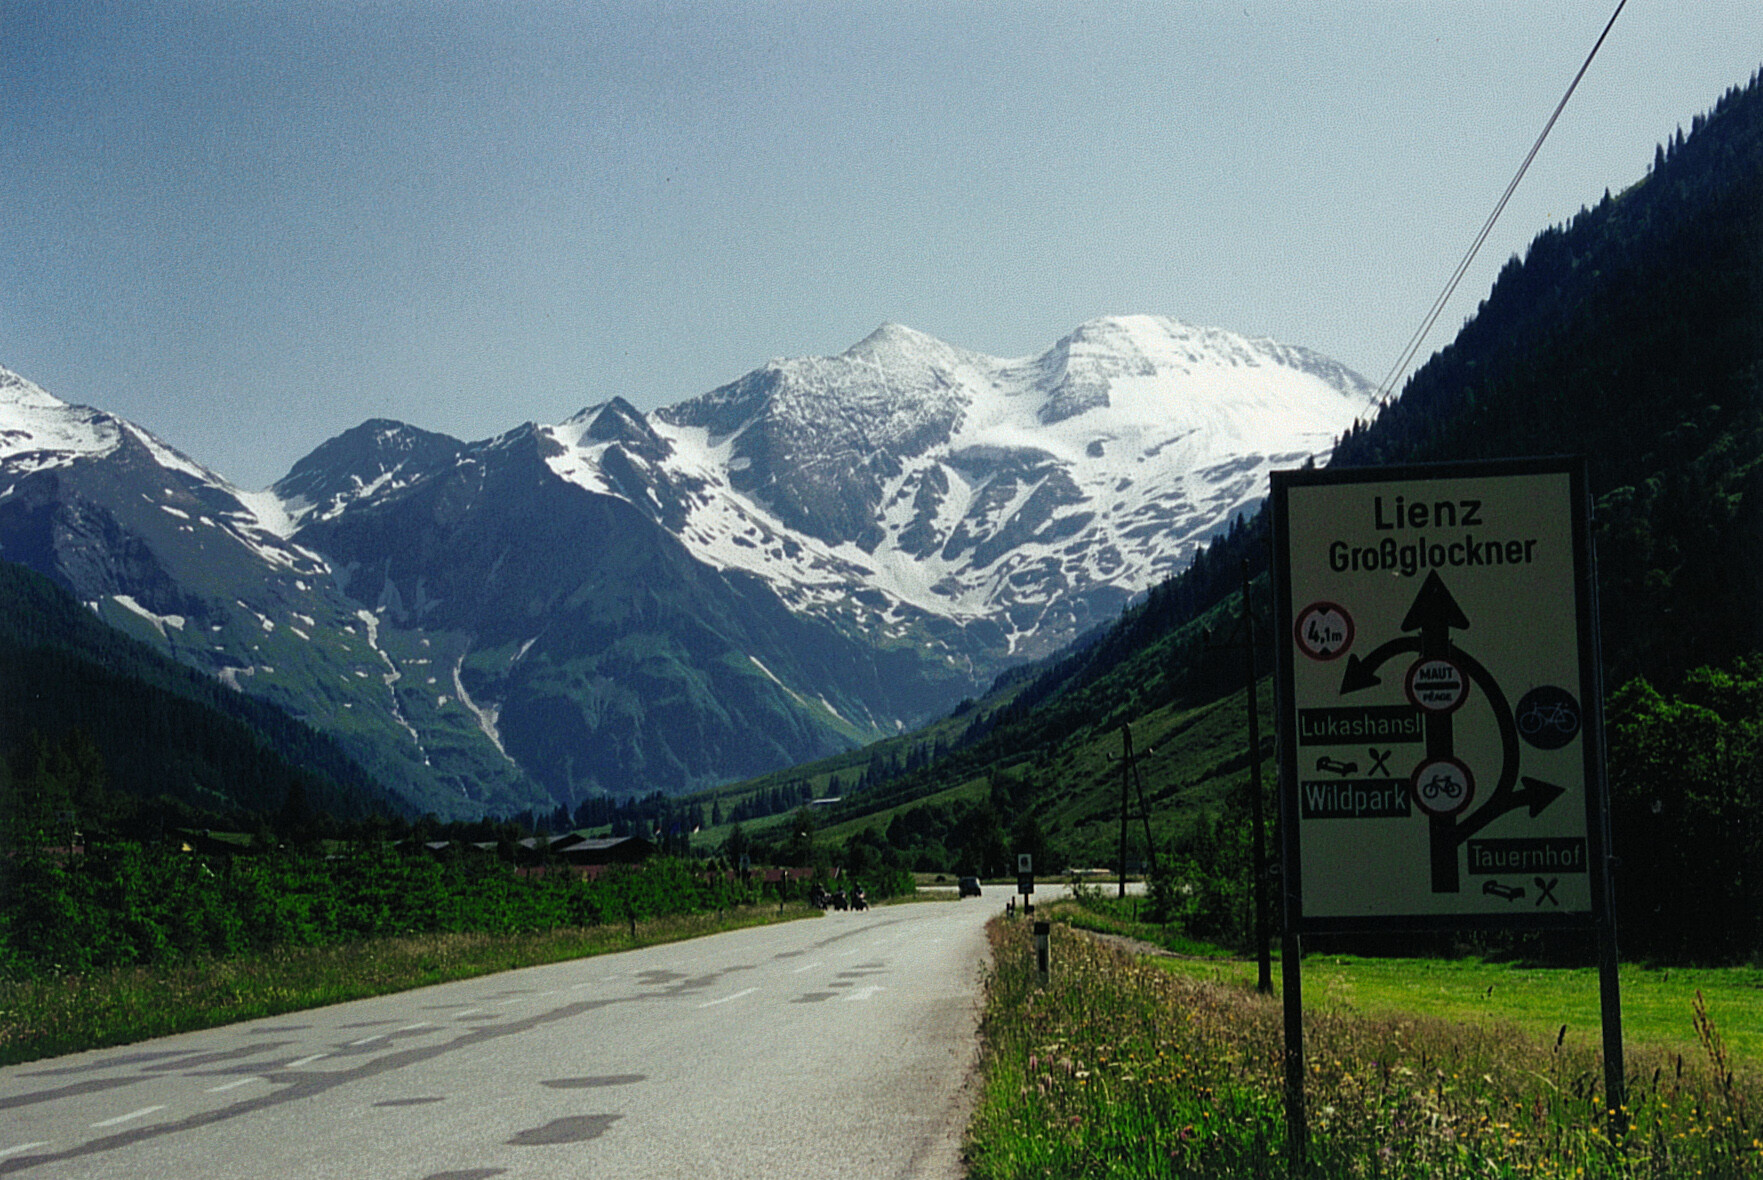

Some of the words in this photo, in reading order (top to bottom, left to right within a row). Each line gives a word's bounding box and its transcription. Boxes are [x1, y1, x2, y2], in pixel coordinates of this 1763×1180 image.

[1374, 496, 1483, 530] Lienz
[1329, 535, 1537, 576] Großglockner
[1419, 667, 1453, 681] MAUT
[1301, 712, 1422, 738] Lukashansl
[1306, 783, 1406, 816] Wildpark
[1472, 845, 1582, 869] Tauernhof
